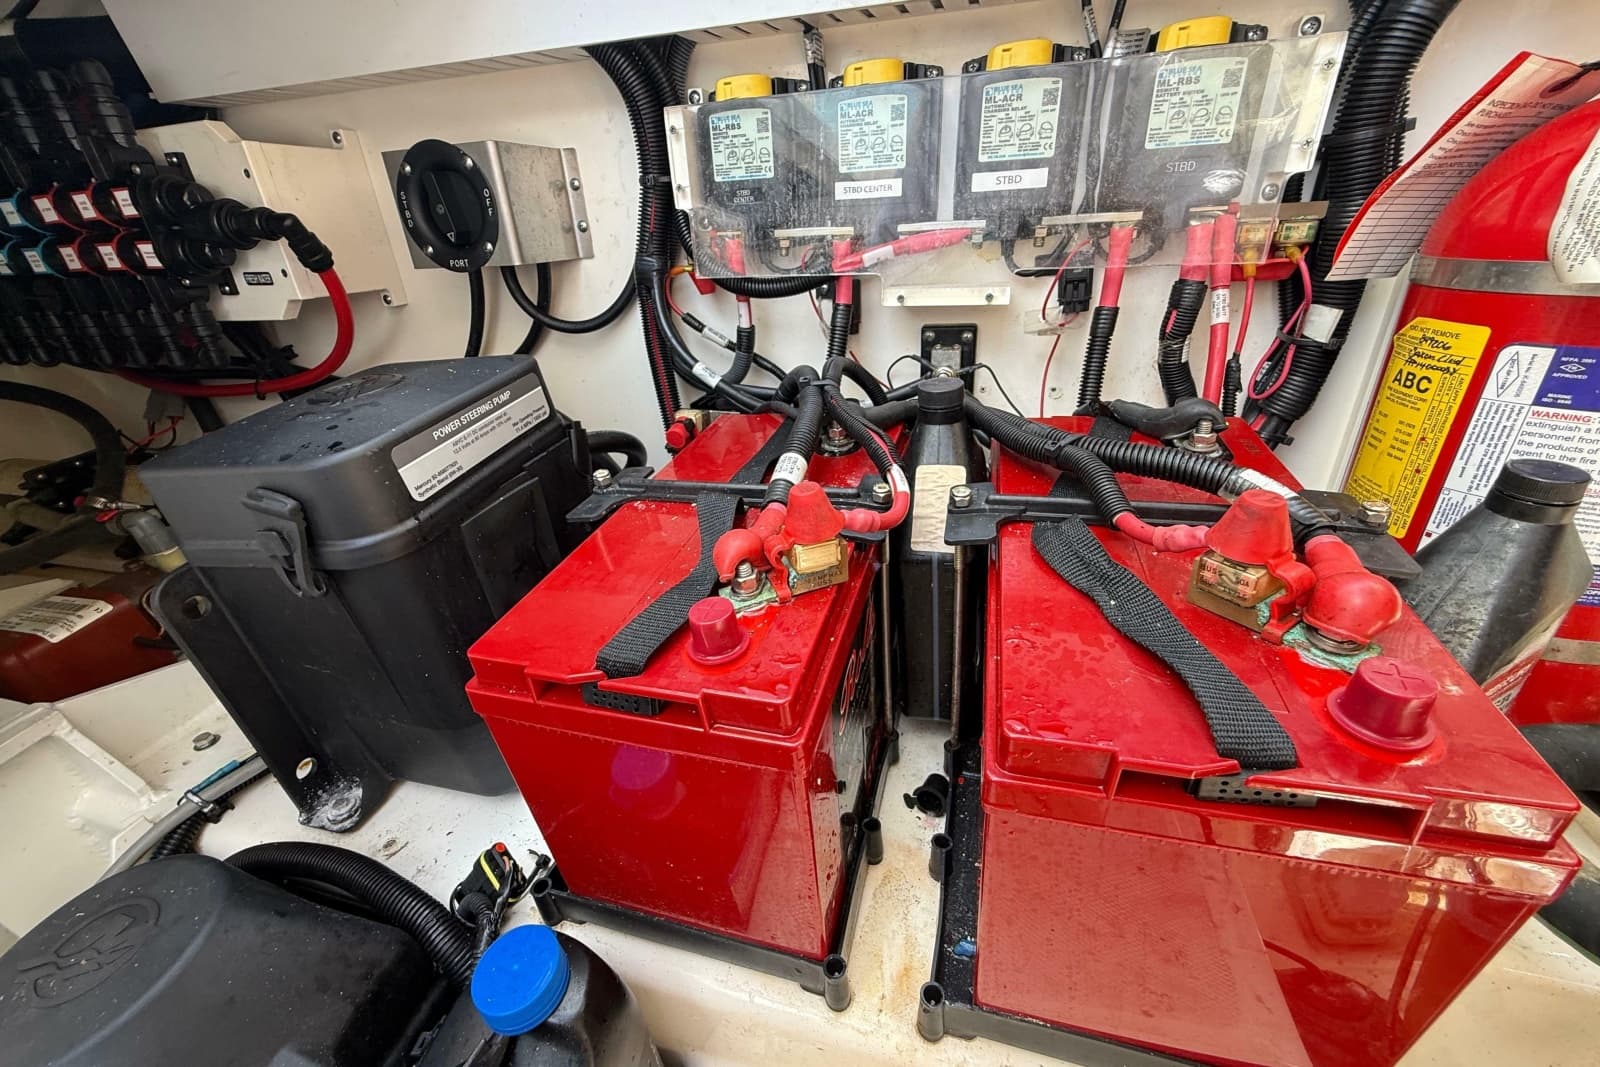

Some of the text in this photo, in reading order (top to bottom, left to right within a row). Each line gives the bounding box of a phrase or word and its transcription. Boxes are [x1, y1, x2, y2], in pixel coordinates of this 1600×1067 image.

[1157, 76, 1200, 88] ML-RBS
[984, 93, 1023, 105] ML-ACR
[840, 109, 874, 119] ML-ACR
[712, 122, 742, 132] ML-RBS
[995, 175, 1023, 186] STBD
[736, 189, 751, 197] STBD
[843, 183, 893, 194] STBD CENTER
[483, 188, 495, 217] OFF
[733, 196, 755, 204] CENTER
[400, 191, 414, 228] STBD
[449, 258, 469, 268] PORT
[1409, 324, 1461, 340] DO NOT REMOVE
[1391, 368, 1433, 394] ABC
[432, 390, 511, 441] POWER STEERING PUMP
[1428, 405, 1436, 424] WATER
[1531, 409, 1596, 424] WARNING:
[1526, 420, 1582, 433] extinguish
[1519, 431, 1576, 443] personnel
[1536, 441, 1585, 454] products
[1512, 449, 1597, 465] agent to the fire
[414, 477, 432, 491] Mercury
[418, 481, 438, 498] Synthetic
